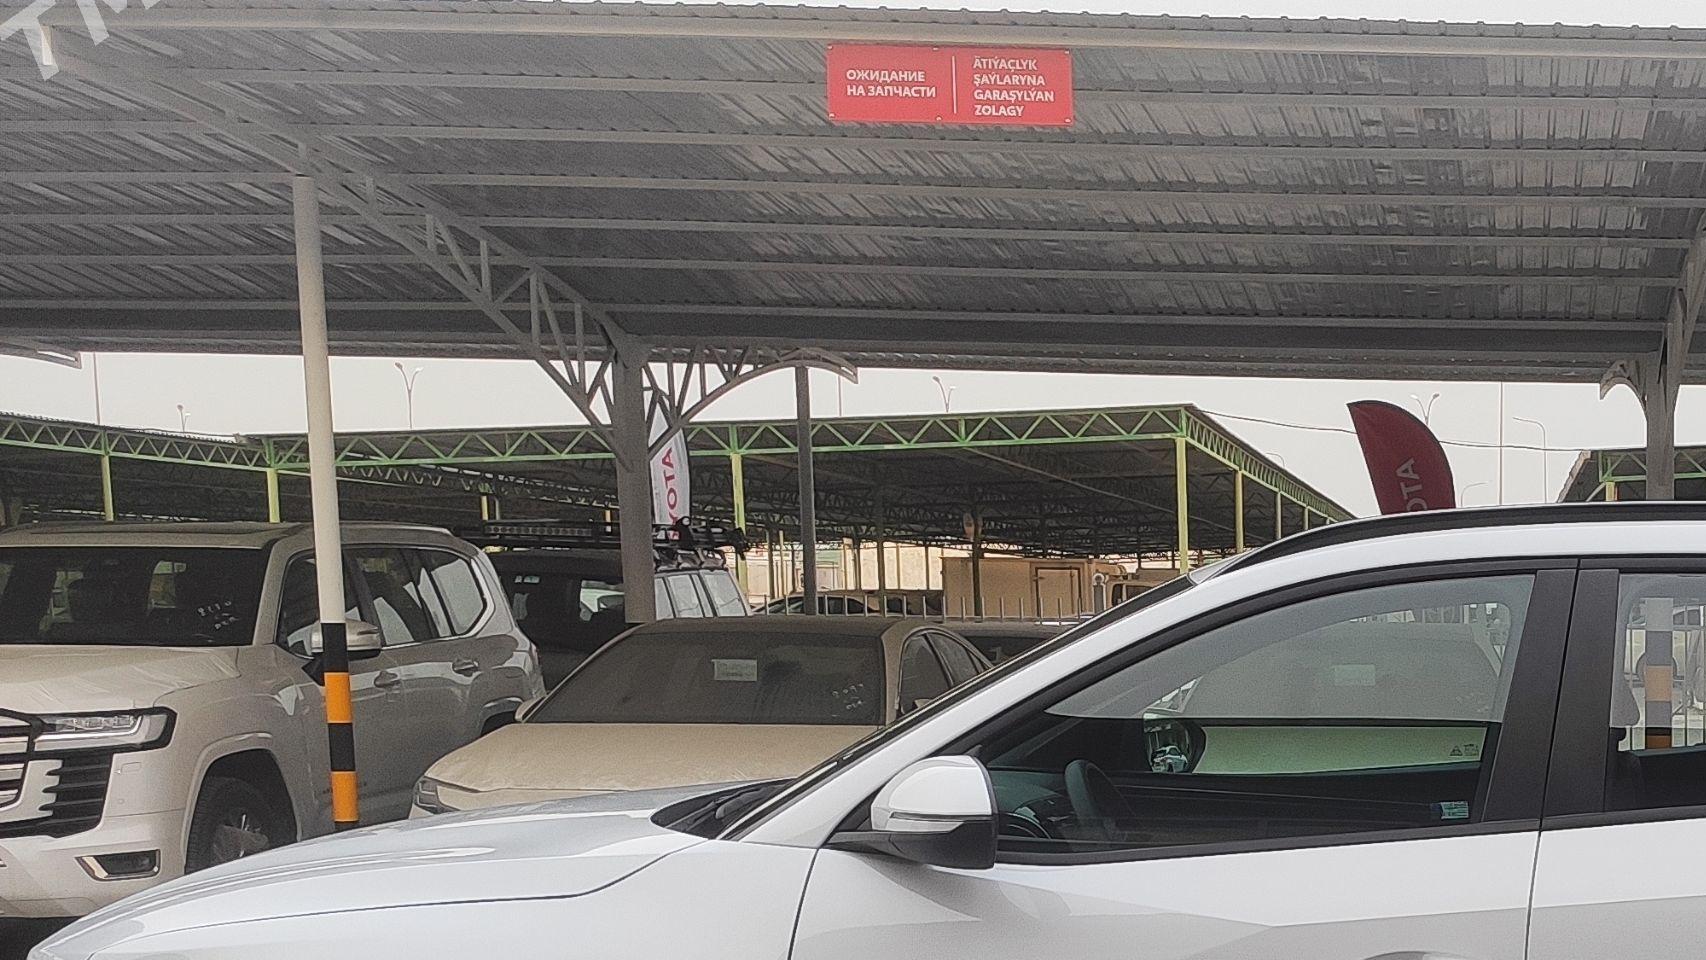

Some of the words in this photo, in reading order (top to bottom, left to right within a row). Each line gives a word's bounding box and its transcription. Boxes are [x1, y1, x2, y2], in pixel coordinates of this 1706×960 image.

[846, 69, 926, 83] ОЖИДАНИЕ
[973, 71, 1046, 87] ŞAÝLARYNA
[846, 84, 866, 96] НА
[867, 85, 937, 98] ЗАПЧАСТИ
[973, 87, 1055, 104] GARAŞYLÝAN
[973, 104, 1025, 117] ZOLAGY
[661, 446, 679, 526] YOTA
